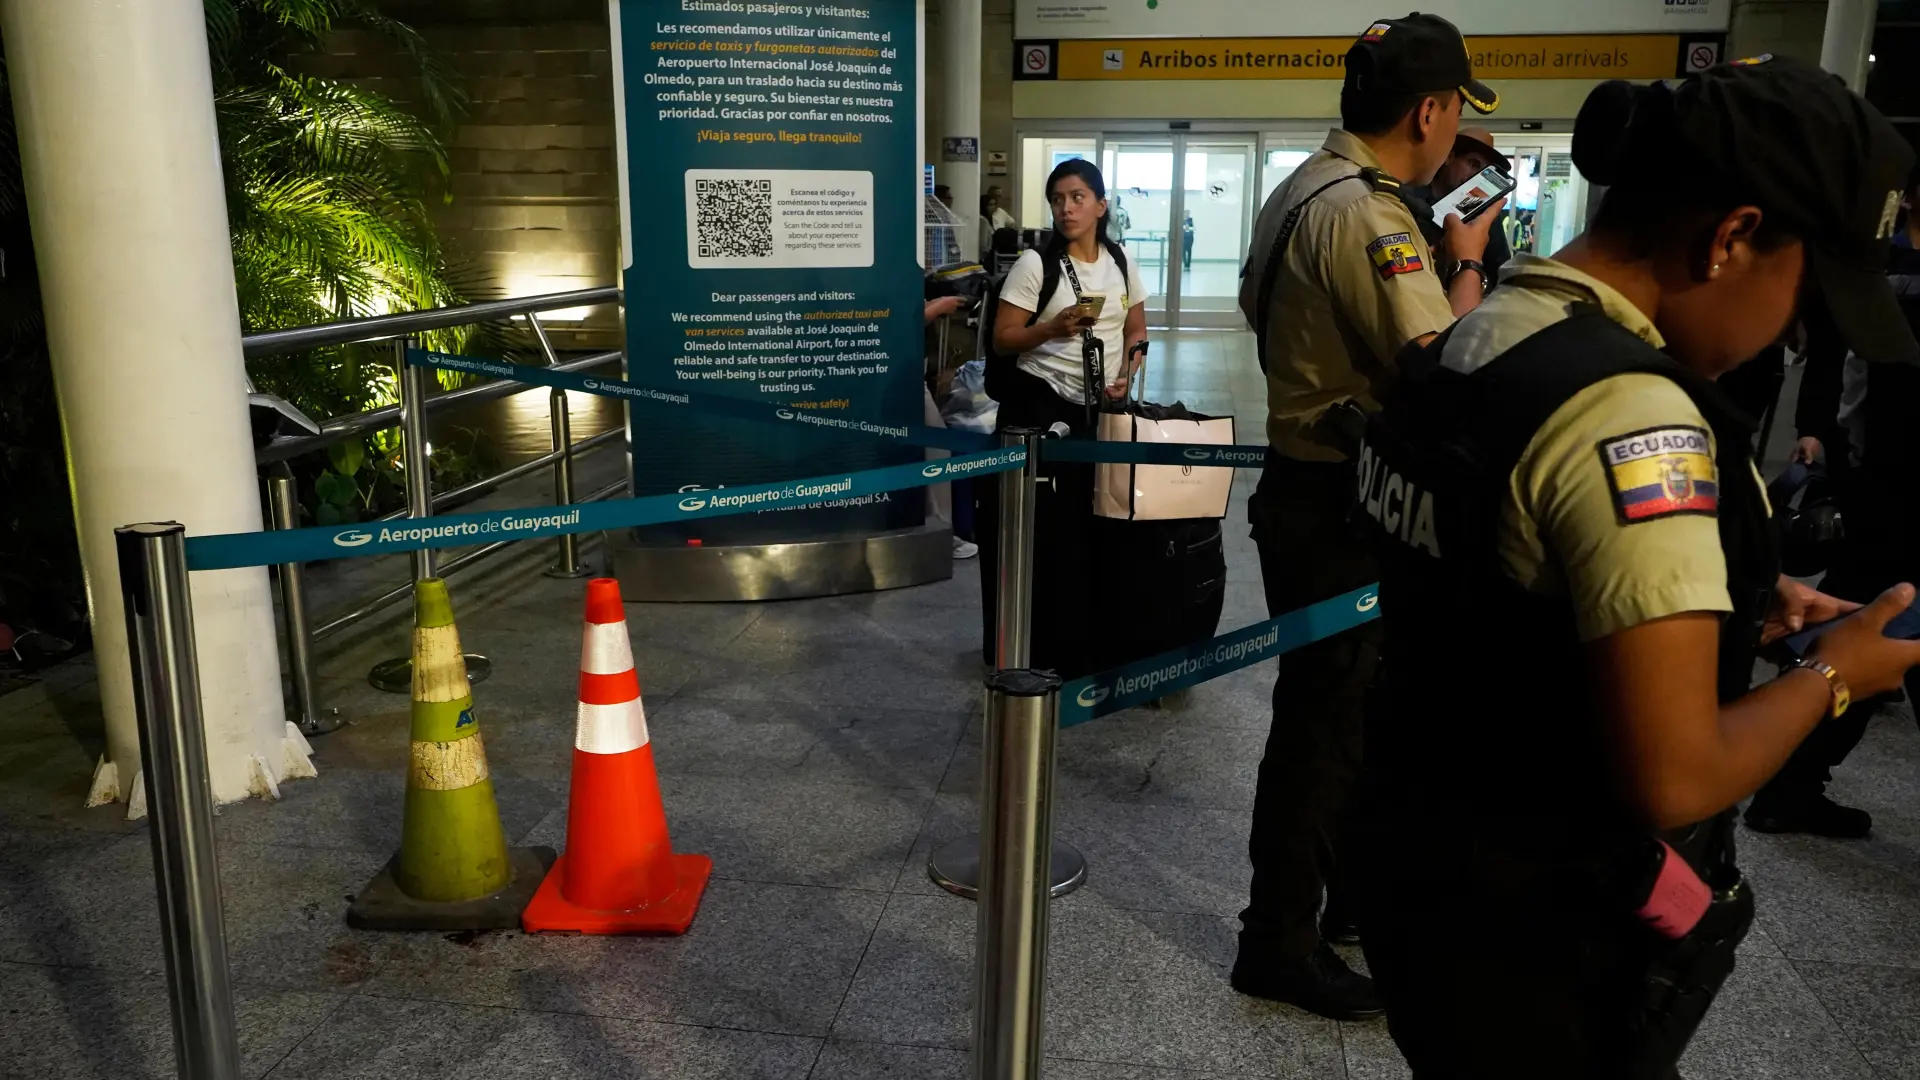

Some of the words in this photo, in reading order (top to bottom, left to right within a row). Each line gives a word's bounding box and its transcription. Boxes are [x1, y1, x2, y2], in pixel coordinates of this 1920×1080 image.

[682, 0, 744, 12] Estimados
[747, 2, 803, 16] pasajeros
[805, 7, 812, 17] y
[814, 5, 869, 18] visitantes:
[657, 22, 677, 33] Les
[680, 23, 772, 35] recomendamos
[775, 25, 815, 37] utilizar
[817, 27, 880, 41] únicamente
[881, 31, 890, 42] el
[651, 39, 696, 50] servicio
[698, 40, 712, 50] de
[715, 40, 743, 51] taxis
[745, 44, 752, 54] y
[754, 41, 815, 55] furgonetas
[818, 45, 878, 57] autorizados
[881, 47, 896, 59] del
[1138, 50, 1218, 69] Arribos
[1470, 47, 1549, 69] ational
[1552, 47, 1629, 69] arrivals
[658, 57, 727, 70] Aeropuerto
[730, 58, 807, 70] Internacional
[809, 60, 834, 72] José
[835, 61, 877, 75] Joaquín
[879, 64, 892, 75] de
[644, 73, 695, 86] Olmedo,
[698, 76, 725, 87] para
[728, 77, 743, 85] un
[745, 75, 794, 86] traslado
[796, 76, 825, 88] hacia
[828, 80, 840, 88] su
[842, 78, 881, 90] destino
[883, 81, 903, 91] más
[657, 90, 712, 102] confiable
[714, 94, 722, 104] y
[724, 94, 768, 105] seguro.
[770, 92, 785, 103] Su
[788, 92, 840, 104] bienestar
[842, 97, 854, 105] es
[856, 97, 893, 107] nuestra
[659, 107, 718, 121] prioridad.
[721, 108, 764, 119] Gracias
[767, 111, 787, 122] por
[789, 109, 828, 120] confiar
[830, 113, 843, 121] en
[846, 113, 892, 123] nosotros.
[698, 130, 730, 143] ¡Viaja
[733, 133, 776, 143] seguro,
[779, 131, 806, 144] llega
[809, 132, 861, 144] tranquilo!
[827, 189, 850, 198] código
[785, 242, 817, 250] regarding
[1370, 234, 1410, 253] ECUADOR
[712, 292, 736, 302] Dear
[739, 294, 796, 304] passengers
[798, 291, 817, 301] and
[819, 291, 855, 300] visitors:
[671, 312, 688, 322] We
[690, 312, 752, 322] recommend
[755, 312, 783, 323] using
[785, 311, 802, 321] the
[804, 310, 854, 320] authorized
[855, 310, 871, 318] taxi
[872, 308, 890, 318] and
[705, 326, 746, 336] services
[747, 325, 793, 336] available
[794, 326, 805, 335] at
[806, 325, 828, 334] José
[829, 323, 866, 335] Joaquín
[867, 323, 879, 332] de
[684, 341, 726, 351] Olmedo
[728, 340, 793, 350] International
[796, 340, 833, 350] Airport,
[835, 338, 848, 347] for
[857, 338, 880, 346] more
[441, 356, 475, 369] Aeropuerto
[481, 362, 514, 376] Guayaquil
[674, 355, 713, 365] reliable
[715, 355, 734, 365] and
[737, 354, 758, 364] safe
[759, 354, 799, 364] transfer
[800, 354, 811, 363] to
[813, 355, 835, 365] your
[836, 350, 890, 361] destination.
[676, 370, 700, 379] Your
[702, 369, 756, 381] well-being
[758, 369, 766, 378] is
[788, 367, 826, 380] priority.
[827, 366, 855, 375] Thank
[857, 366, 874, 377] you
[876, 364, 888, 373] for
[600, 382, 642, 396] Aeropuerto
[650, 390, 689, 404] Guayaquil
[760, 382, 799, 394] trusting
[820, 399, 849, 410] safely!
[796, 412, 848, 428] Aeropuerto
[860, 421, 908, 438] Guayaquil
[945, 457, 997, 474] Aeropuerto
[1009, 452, 1027, 462] Gua
[709, 490, 780, 508] Aeropuerto
[795, 478, 851, 497] Guayaquil
[379, 522, 479, 543] Aeropuerto
[501, 510, 579, 532] Guayaquil
[1115, 656, 1197, 698] Aeropuerto
[1215, 625, 1279, 664] Guayaquil
